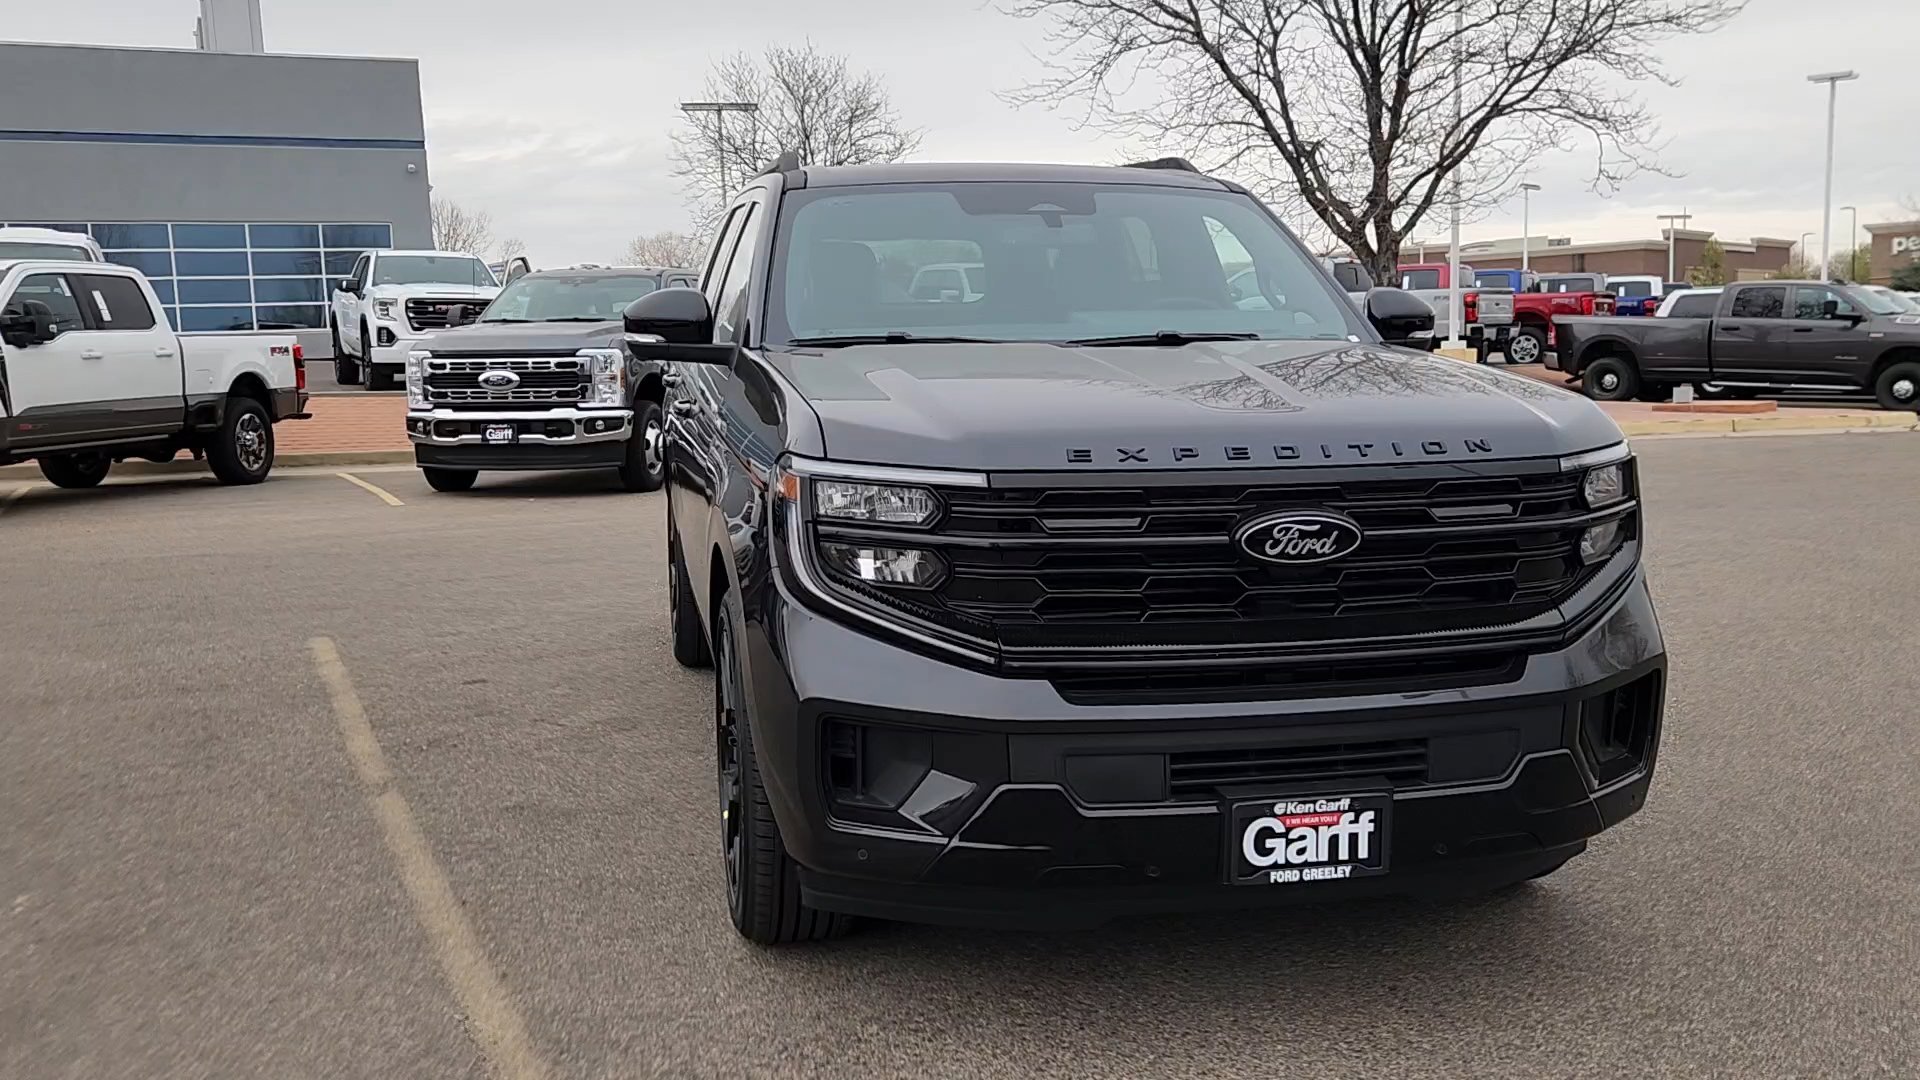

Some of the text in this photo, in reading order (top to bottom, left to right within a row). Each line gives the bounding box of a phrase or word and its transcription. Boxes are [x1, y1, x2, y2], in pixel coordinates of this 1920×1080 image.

[269, 345, 290, 356] FX4
[486, 428, 513, 440] Garff
[1065, 437, 1494, 464] EXPEDITION
[1264, 523, 1338, 557] Ford
[1286, 798, 1351, 814] Ken Garff
[1302, 816, 1319, 824] HEAR
[1320, 815, 1333, 823] YOU
[1242, 810, 1375, 867] Garff
[1270, 866, 1352, 884] FORD GREELEY
